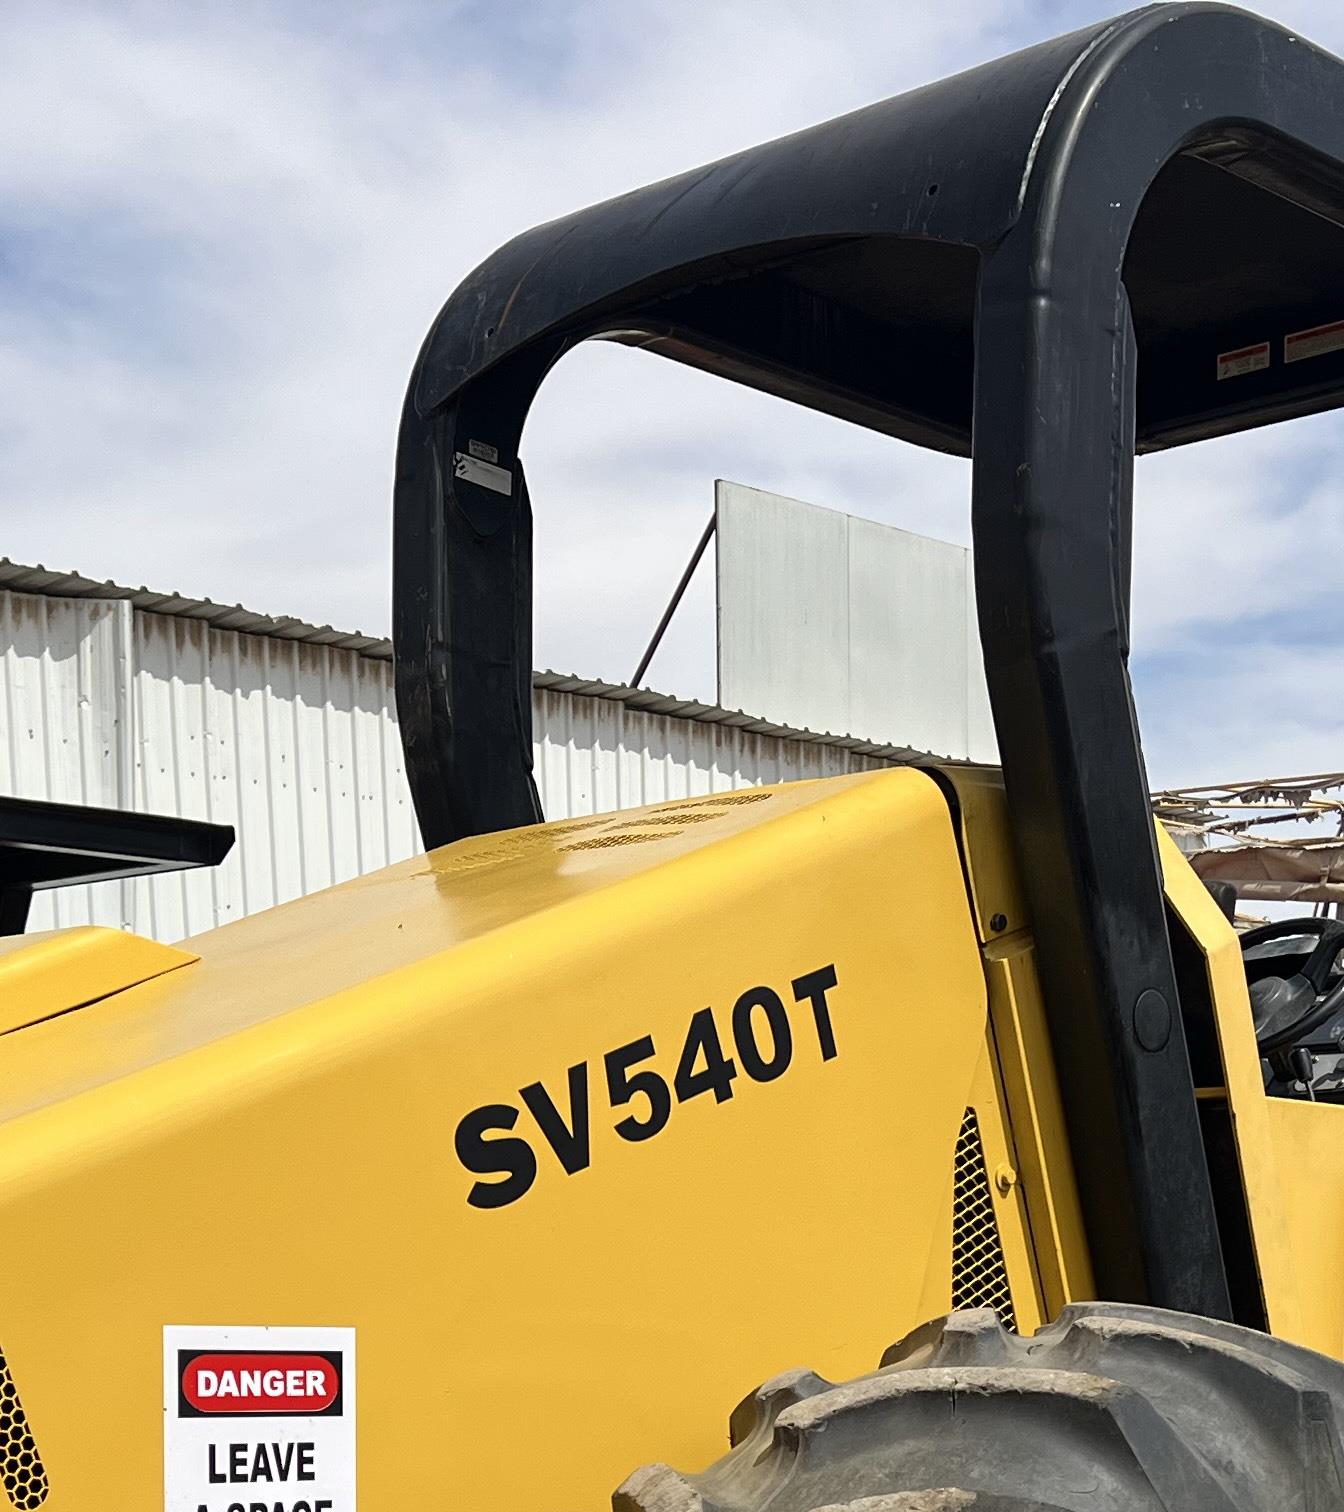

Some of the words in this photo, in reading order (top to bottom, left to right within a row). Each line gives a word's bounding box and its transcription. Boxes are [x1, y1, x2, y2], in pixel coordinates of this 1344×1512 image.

[454, 963, 839, 1210] SV540T
[197, 1369, 327, 1398] DANGER
[208, 1441, 316, 1485] LEAVE
